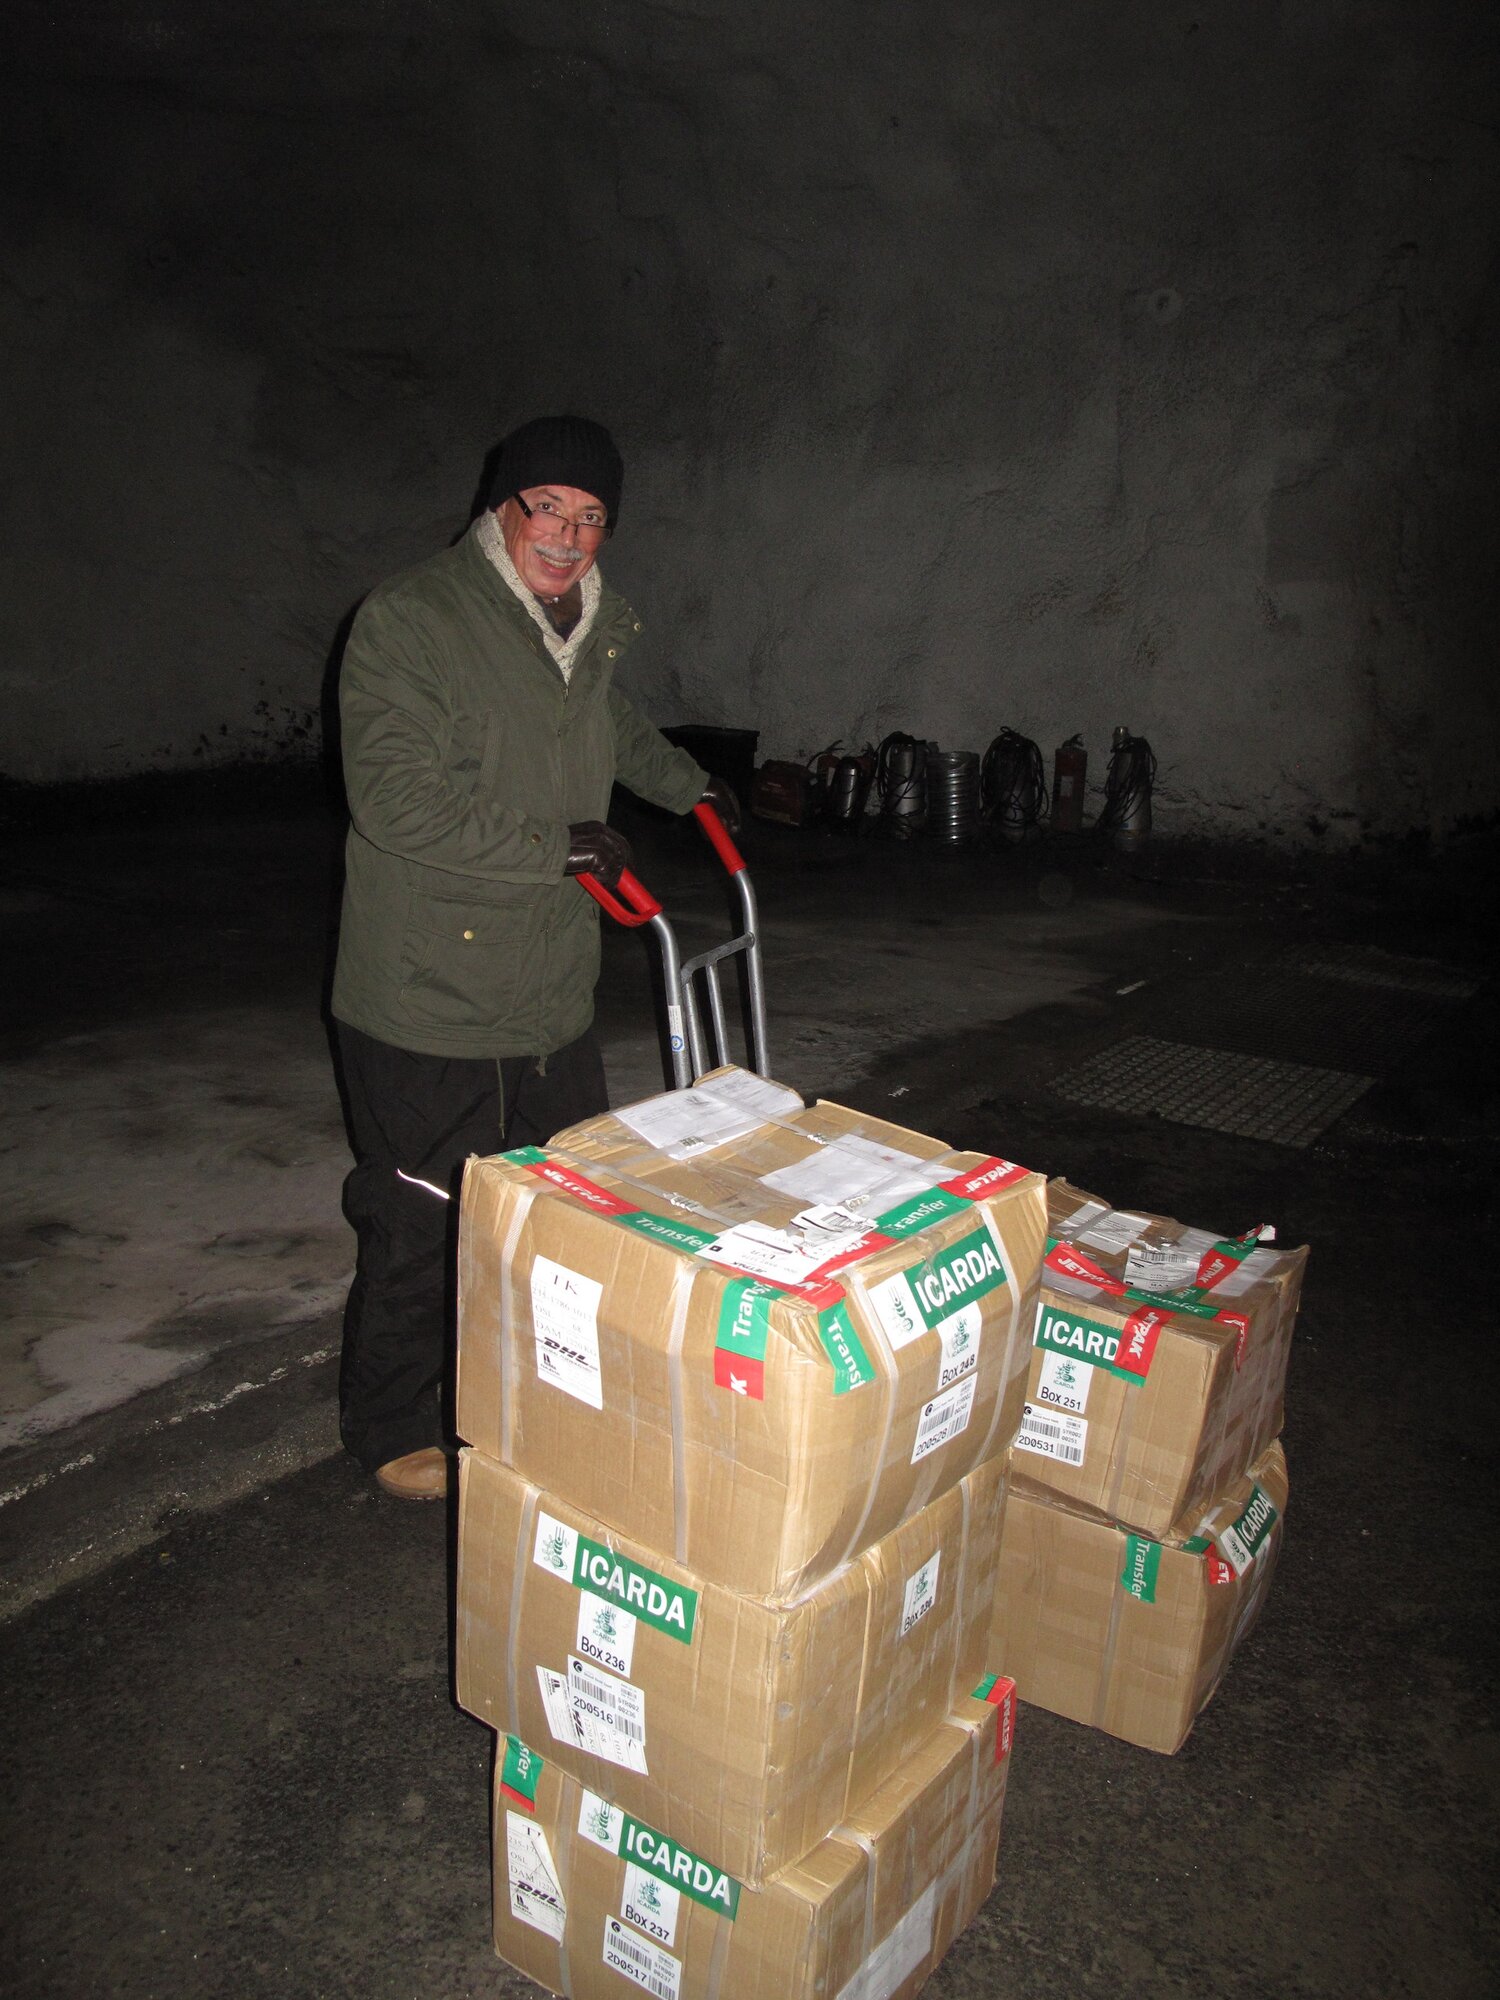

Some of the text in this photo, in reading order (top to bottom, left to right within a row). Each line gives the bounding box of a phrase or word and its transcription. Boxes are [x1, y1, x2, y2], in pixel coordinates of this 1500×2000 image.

[966, 1161, 1018, 1193] JETPAK
[915, 1242, 1001, 1313] ICARDA
[1044, 1316, 1120, 1361] ICARD
[1129, 1311, 1159, 1359] JETPAK
[544, 1336, 589, 1366] DHL
[960, 1354, 975, 1373] 248
[1053, 1379, 1074, 1390] ICARDA
[1063, 1397, 1081, 1410] 251
[1018, 1435, 1054, 1453] 2D0531
[1238, 1492, 1272, 1547] ICARDA
[1131, 1542, 1150, 1600] Transfer
[580, 1548, 685, 1629] ICARDA
[592, 1630, 616, 1645] ICARDA
[605, 1652, 625, 1671] 236
[573, 1695, 613, 1724] 2D0516
[627, 1824, 731, 1906] ICARDA
[518, 1880, 559, 1908] DHL
[637, 1899, 660, 1915] ICARDA
[650, 1922, 669, 1941] 237
[607, 1951, 647, 1982] 2D0517
